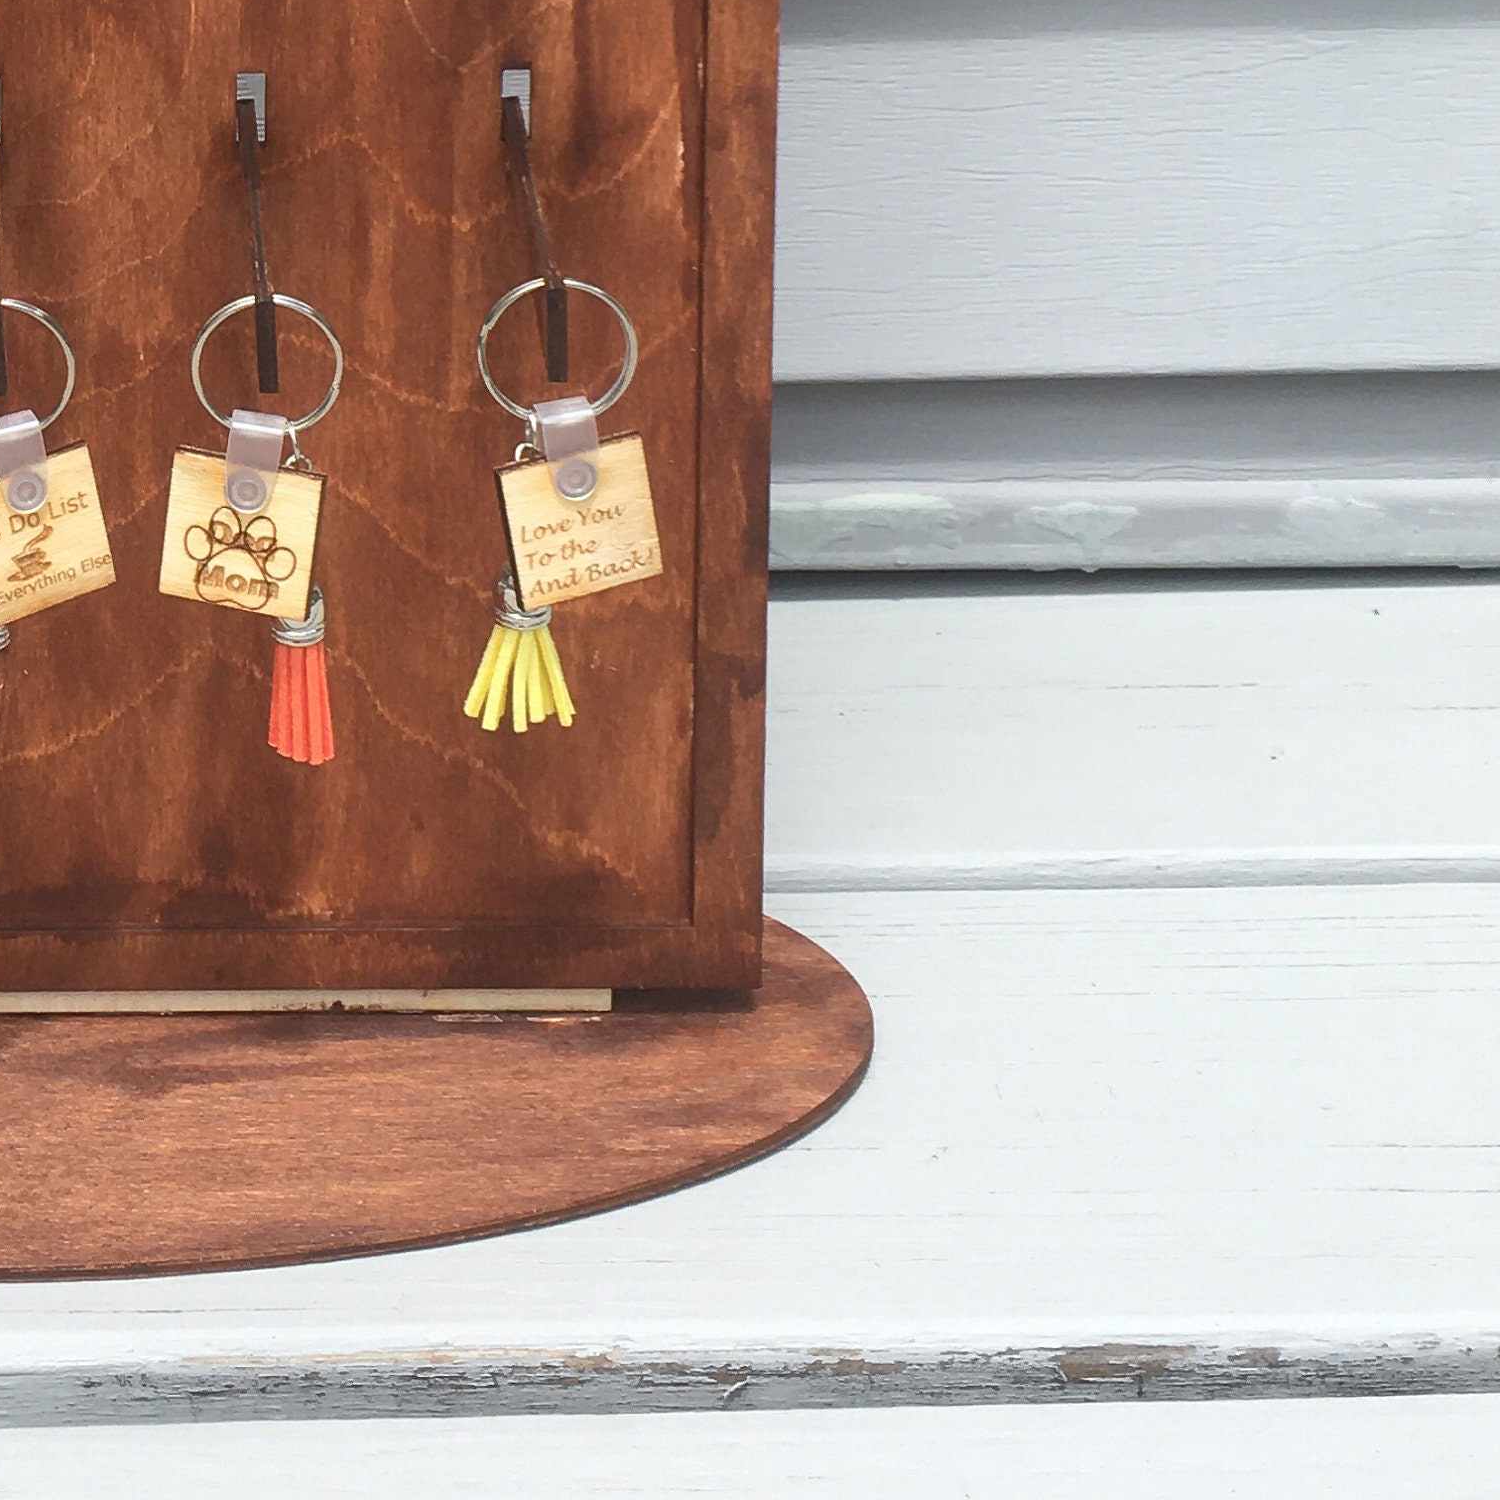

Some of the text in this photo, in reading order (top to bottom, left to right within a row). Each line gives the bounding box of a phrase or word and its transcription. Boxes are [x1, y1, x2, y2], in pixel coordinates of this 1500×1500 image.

[8, 512, 41, 535] Do
[47, 491, 89, 520] List
[520, 505, 625, 545] Love You
[80, 554, 113, 574] Else
[524, 538, 598, 570] To the
[193, 563, 280, 600] Mom
[529, 567, 582, 598] And
